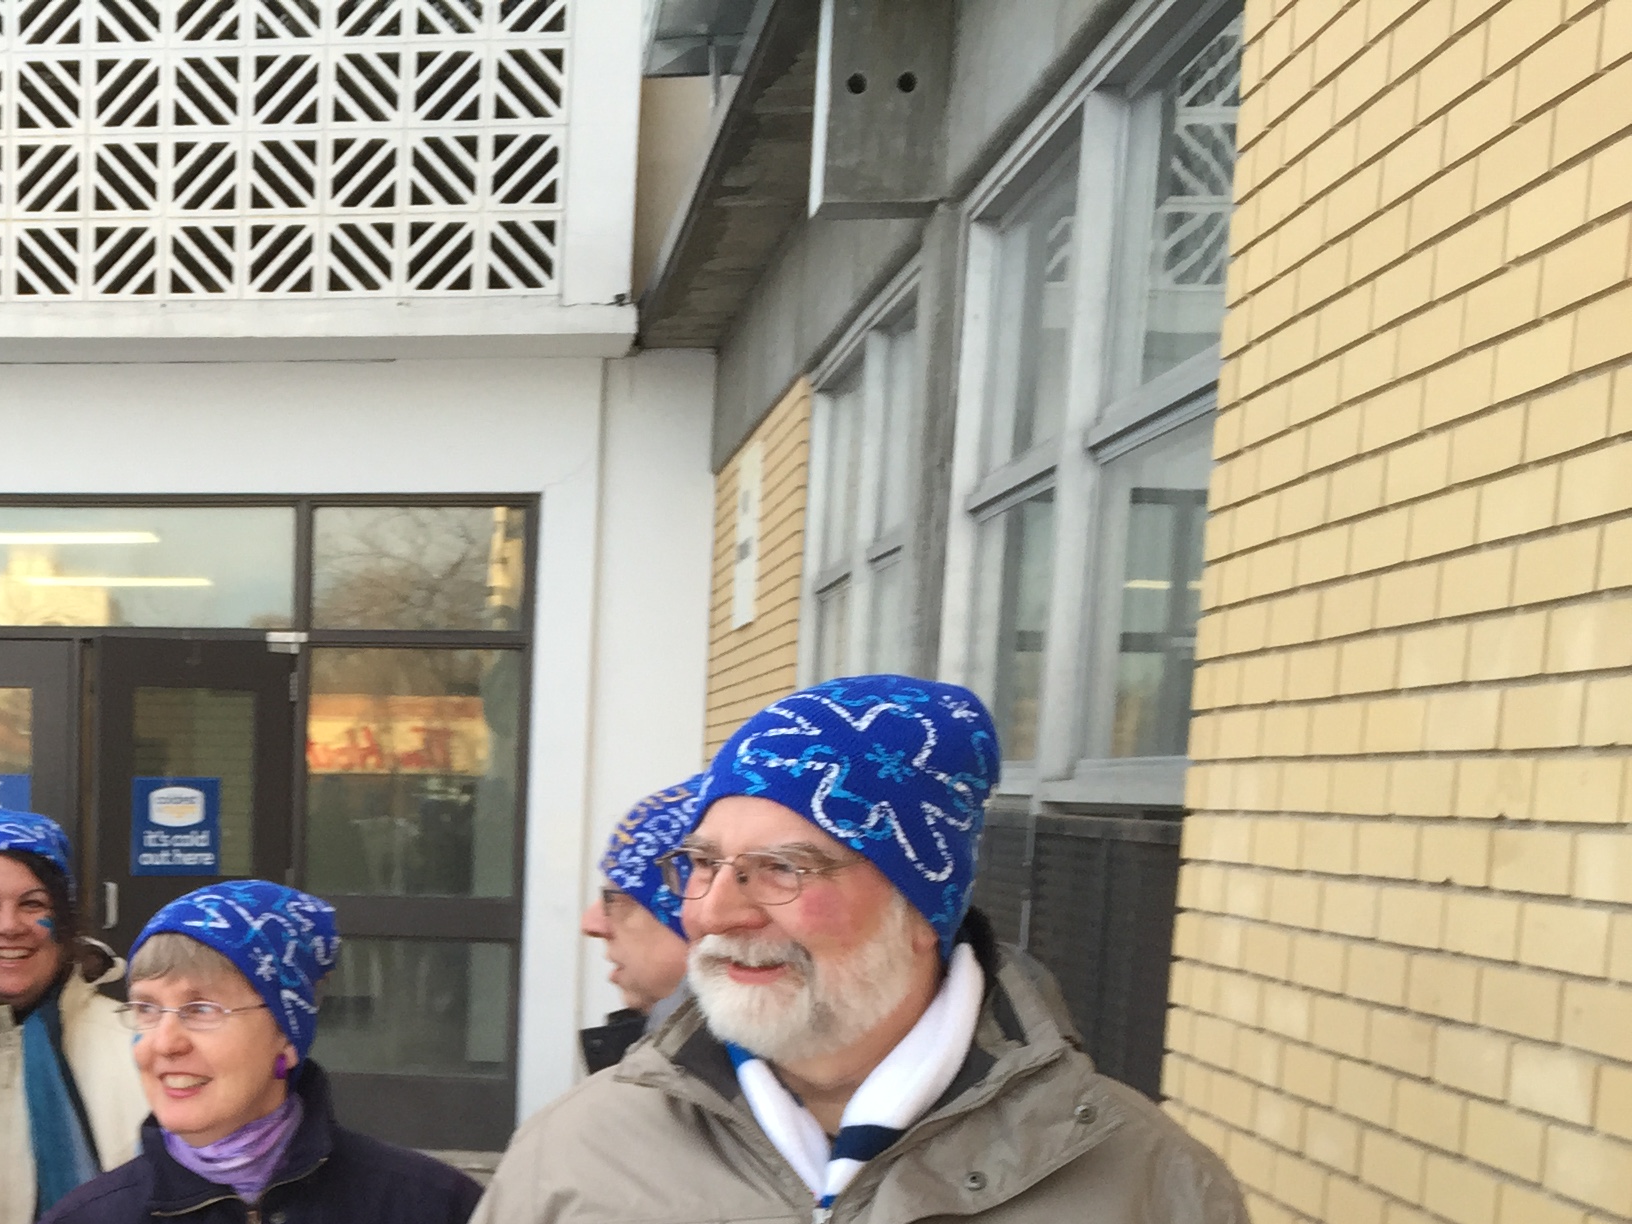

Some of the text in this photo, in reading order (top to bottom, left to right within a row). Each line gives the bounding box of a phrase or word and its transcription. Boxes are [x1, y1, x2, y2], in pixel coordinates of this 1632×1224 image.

[142, 830, 210, 847] it's cold
[138, 849, 215, 865] out here
